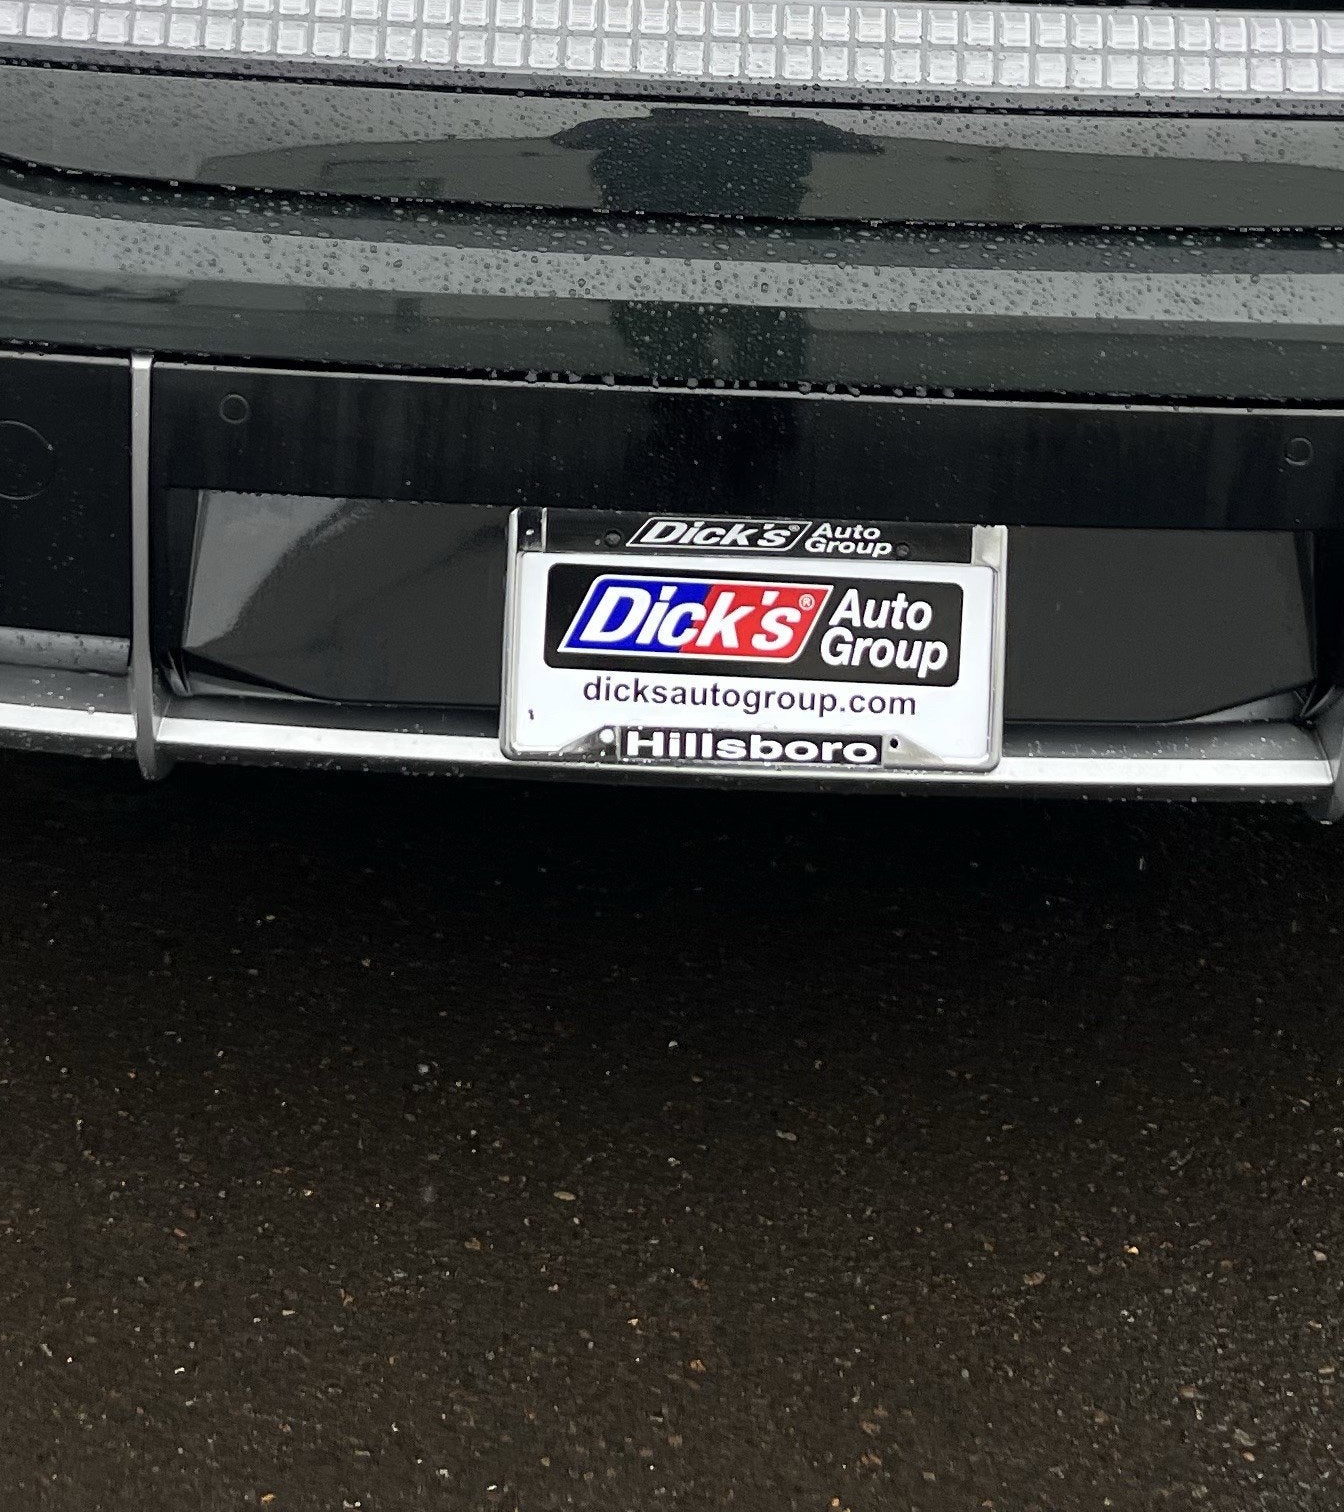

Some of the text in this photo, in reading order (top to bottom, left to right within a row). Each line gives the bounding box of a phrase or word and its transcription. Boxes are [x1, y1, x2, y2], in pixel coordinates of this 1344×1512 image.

[804, 538, 893, 558] Group
[811, 522, 881, 539] Auto
[830, 589, 934, 631] Auto
[820, 627, 949, 678] Group
[582, 676, 917, 716] dicksautogroup.com
[626, 731, 877, 764] Hillsboro
